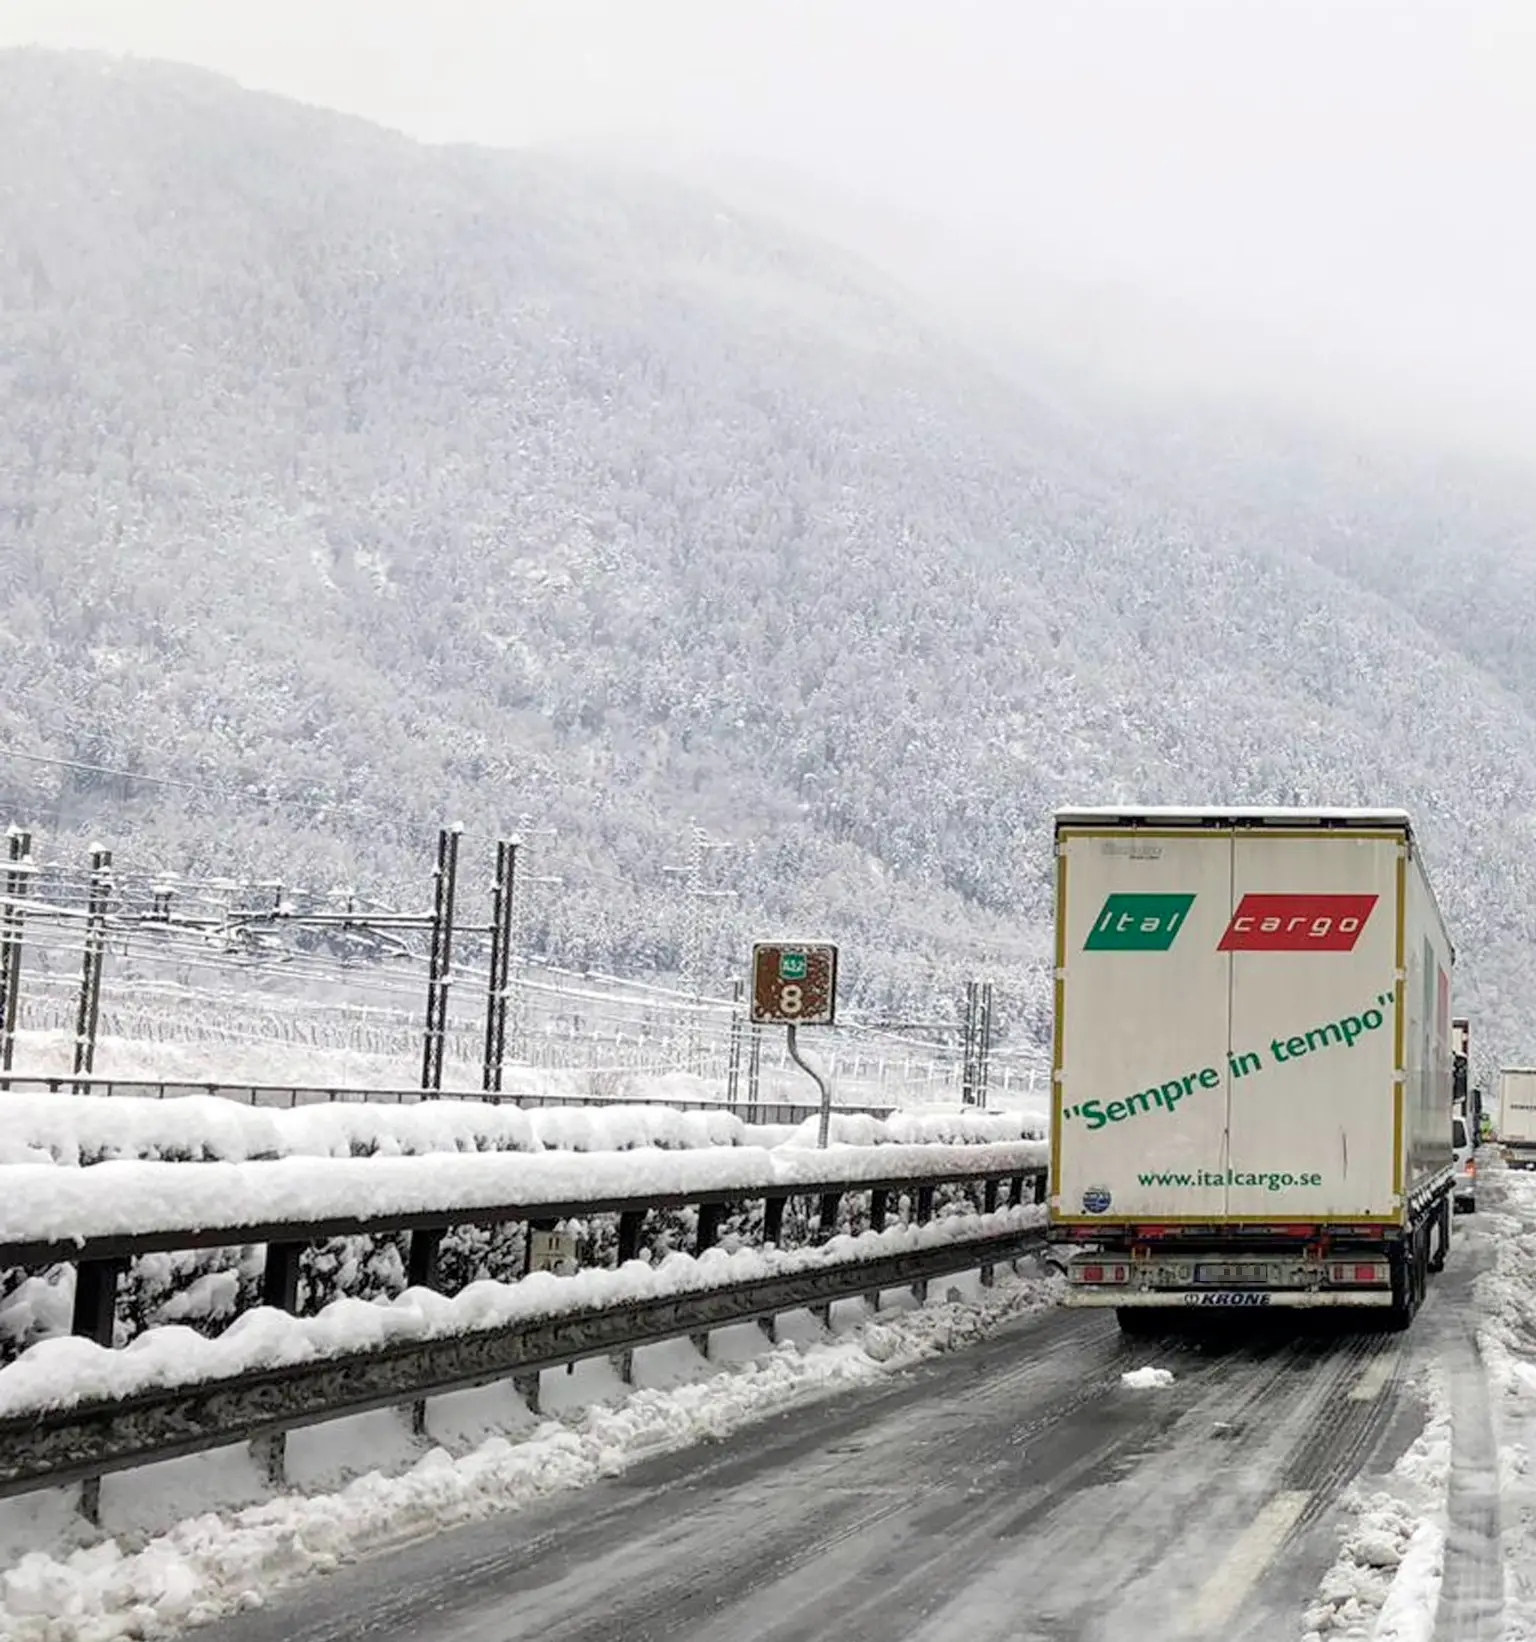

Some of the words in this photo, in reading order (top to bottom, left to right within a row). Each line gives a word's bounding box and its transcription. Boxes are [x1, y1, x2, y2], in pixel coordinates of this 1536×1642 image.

[1099, 912, 1179, 932] Ital
[1233, 916, 1360, 937] cargo
[781, 985, 803, 1014] 8
[1063, 1067, 1221, 1130] "Sempre
[1228, 1051, 1262, 1078] in
[1269, 992, 1395, 1063] tempo"
[1138, 1169, 1322, 1191] www.italcargo.se
[1202, 1294, 1272, 1305] KRONE
